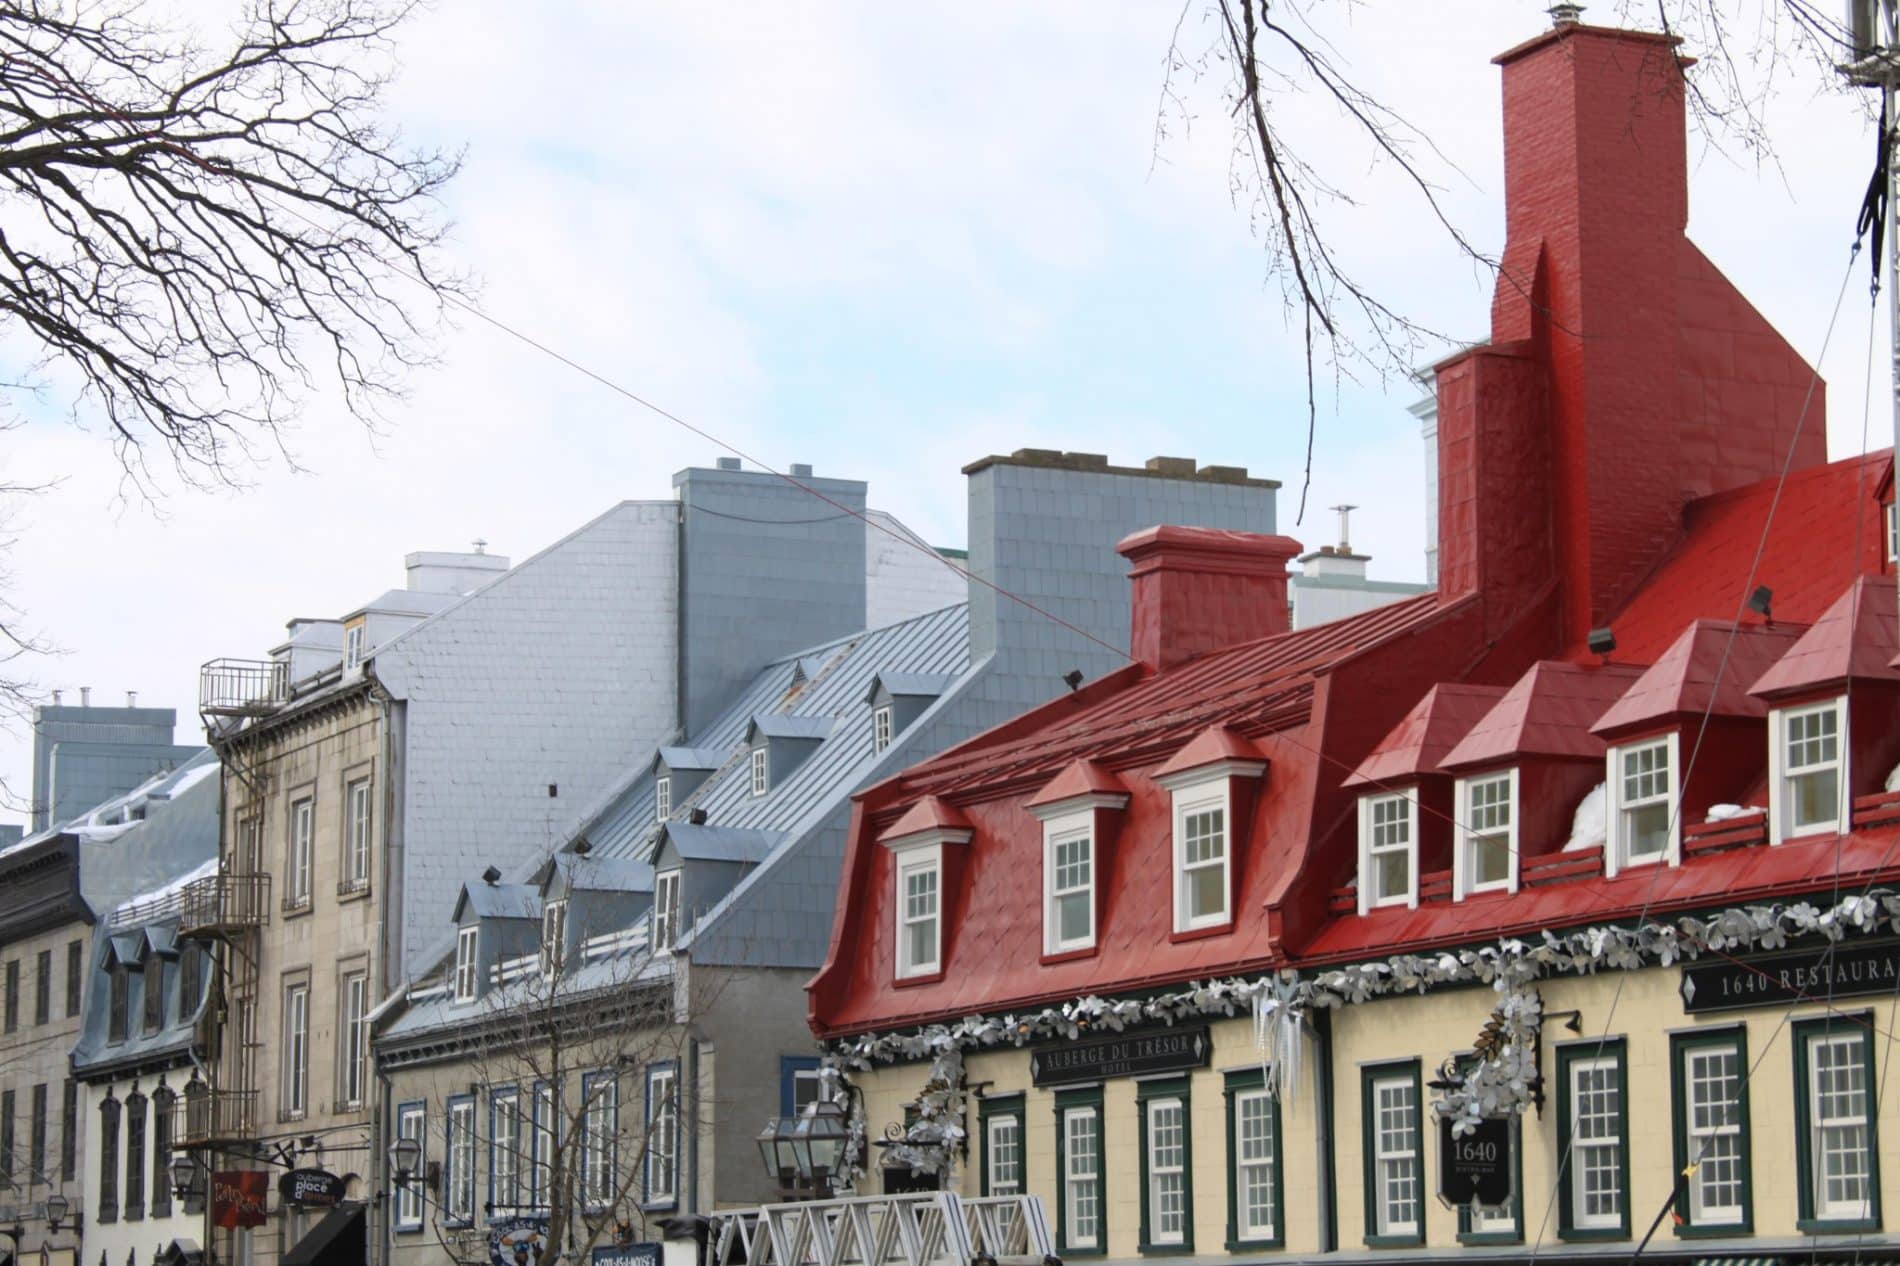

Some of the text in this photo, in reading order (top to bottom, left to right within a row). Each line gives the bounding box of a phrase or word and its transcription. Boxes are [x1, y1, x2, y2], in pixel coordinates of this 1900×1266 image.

[1722, 973, 1767, 995] 1640
[1047, 1046, 1105, 1067] AUBERGE
[1112, 1043, 1129, 1059] DU
[1455, 1142, 1496, 1161] 1640
[296, 1180, 328, 1193] place
